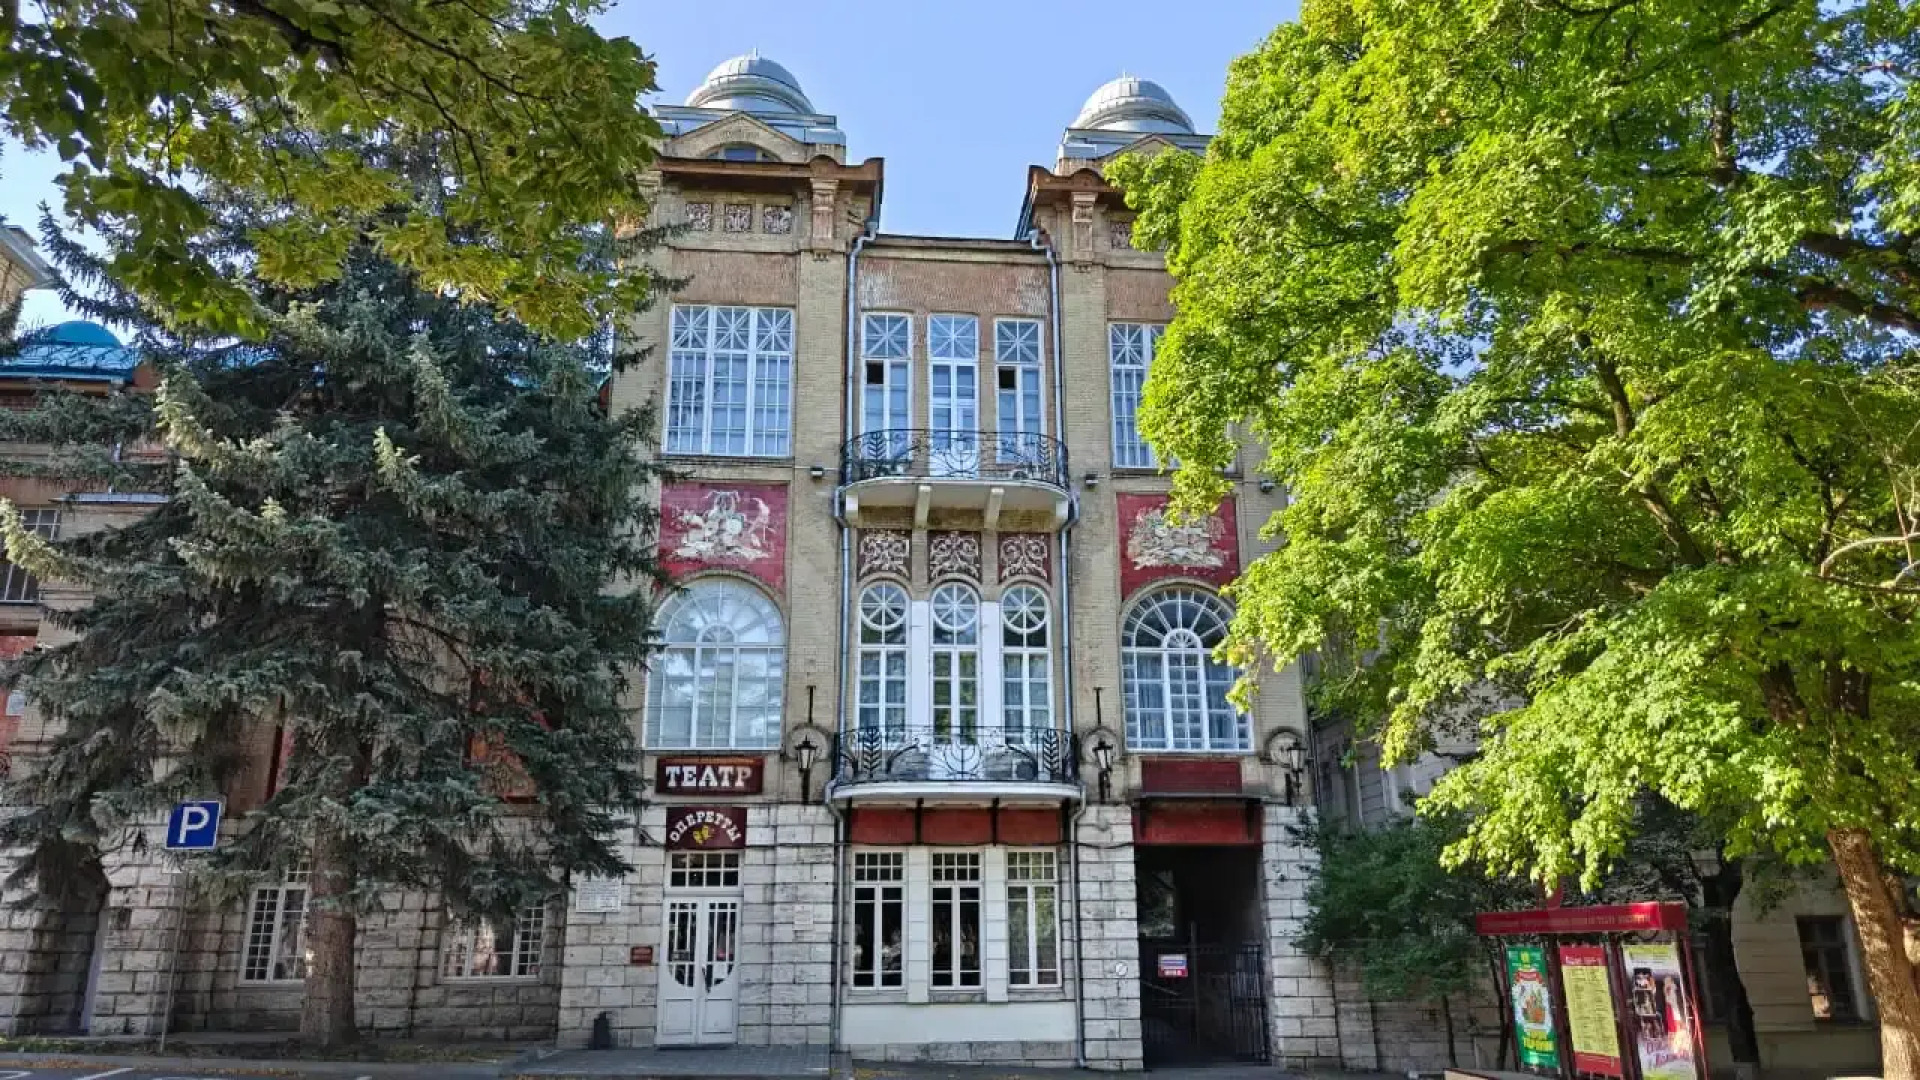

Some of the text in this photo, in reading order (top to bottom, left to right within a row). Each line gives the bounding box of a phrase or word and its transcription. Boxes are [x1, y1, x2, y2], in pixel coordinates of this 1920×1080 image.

[665, 765, 752, 787] ТЕАТР
[178, 806, 210, 843] P
[669, 811, 741, 842] ОПЕРЕТТЫ
